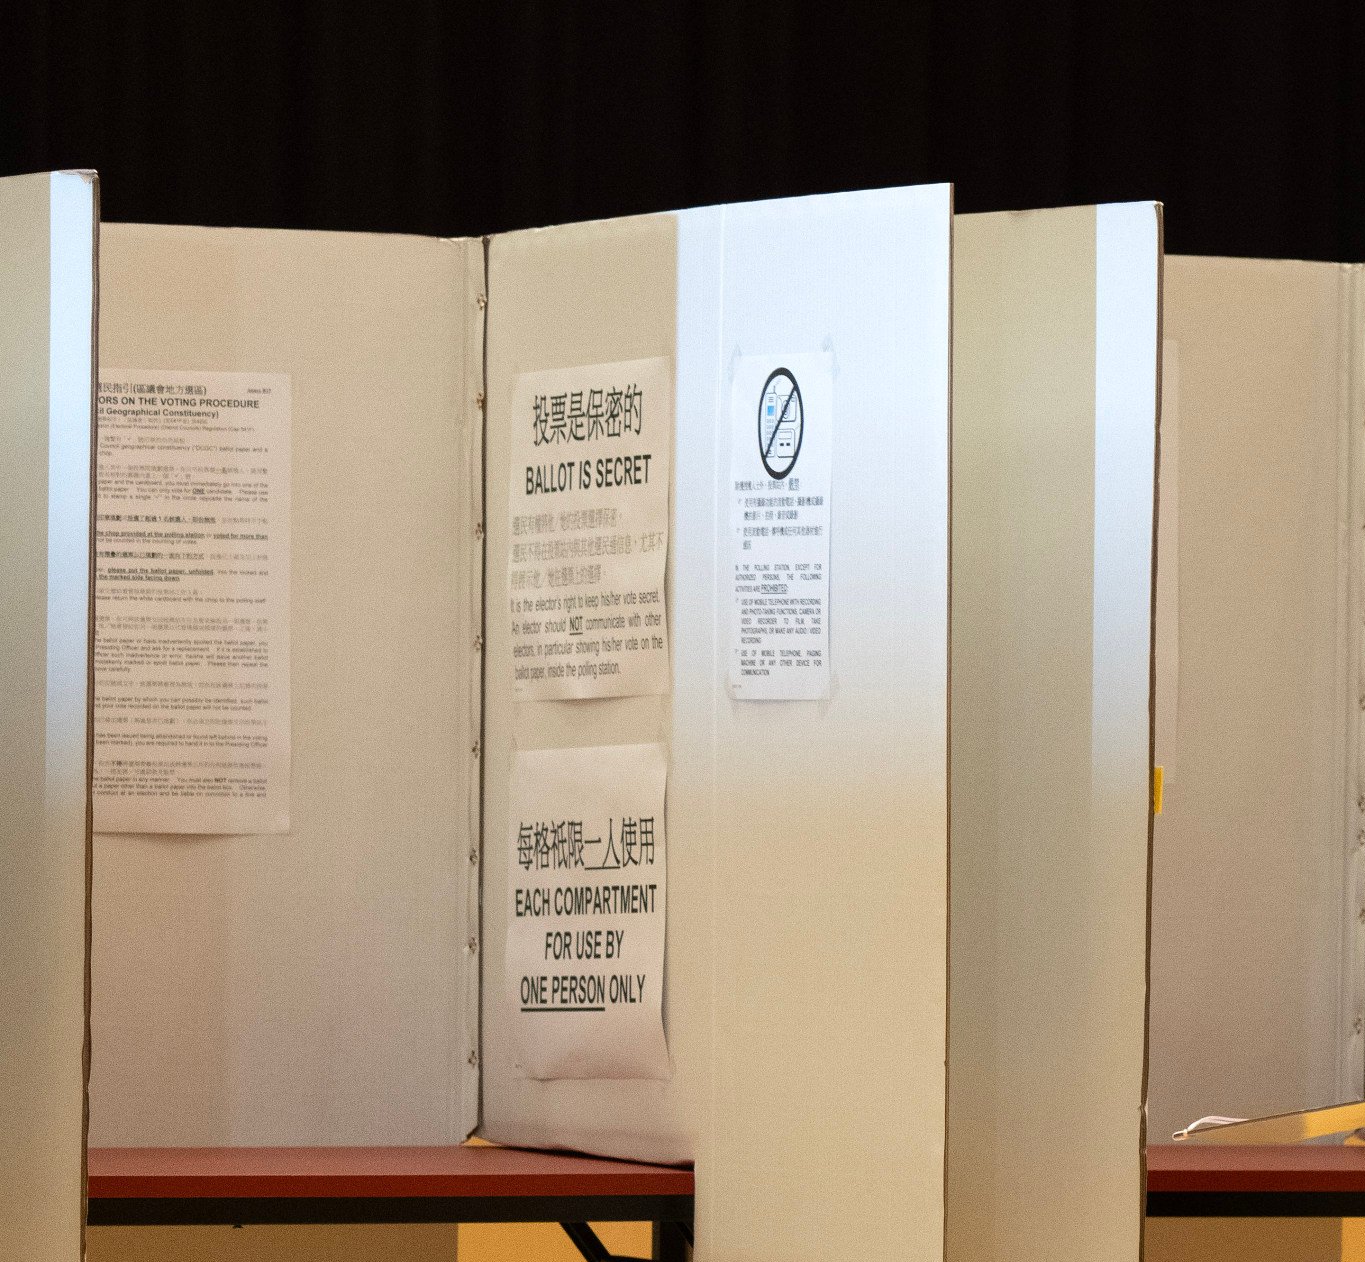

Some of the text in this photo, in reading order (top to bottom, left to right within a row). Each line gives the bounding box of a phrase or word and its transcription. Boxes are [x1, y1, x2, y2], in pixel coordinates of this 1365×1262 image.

[106, 407, 161, 418] Geographical
[121, 396, 136, 406] ON
[138, 396, 158, 407] THE
[160, 397, 197, 408] VOTING
[200, 398, 260, 409] PROCEDURE
[533, 383, 642, 446] 投票是保密的
[526, 454, 652, 495] BALLOT IS SECRET
[569, 616, 583, 631] NOT
[515, 884, 657, 917] EACH COMPARTMENT
[545, 929, 624, 960] FOR USE BY
[520, 974, 646, 1004] ONE PERSON ONLY
